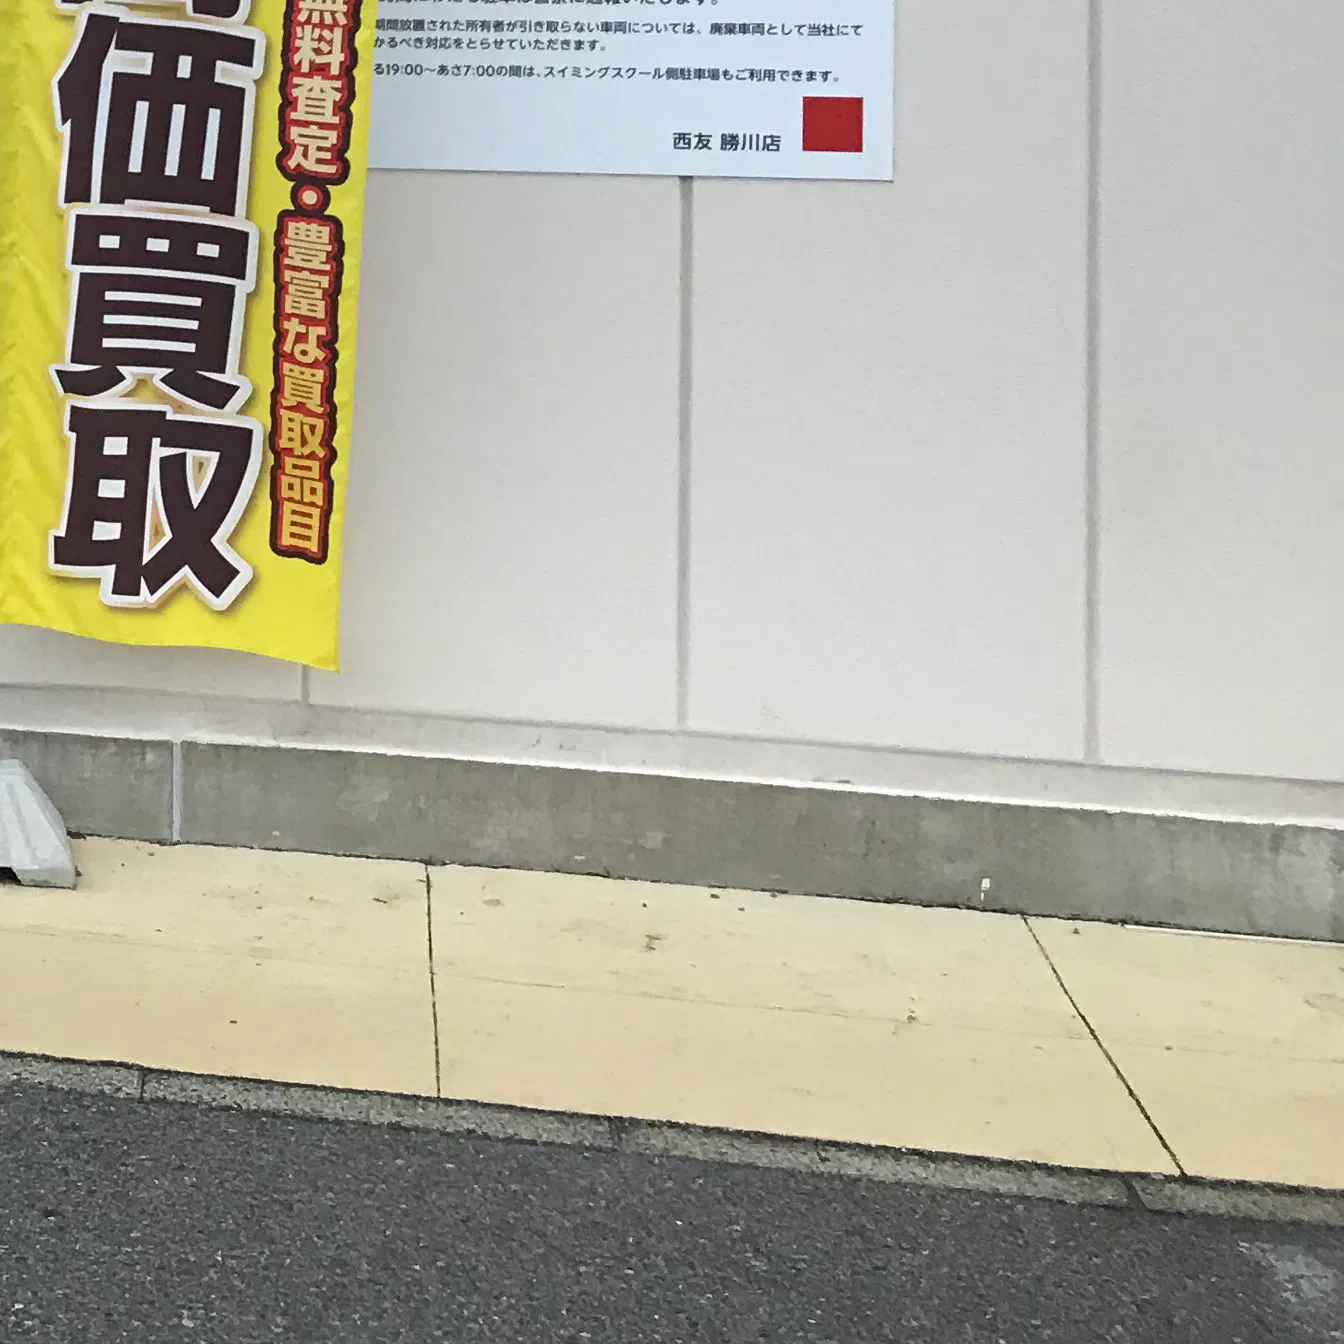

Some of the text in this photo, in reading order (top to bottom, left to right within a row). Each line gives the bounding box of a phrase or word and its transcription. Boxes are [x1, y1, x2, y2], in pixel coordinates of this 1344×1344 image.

[672, 131, 782, 153] 西友 勝川店
